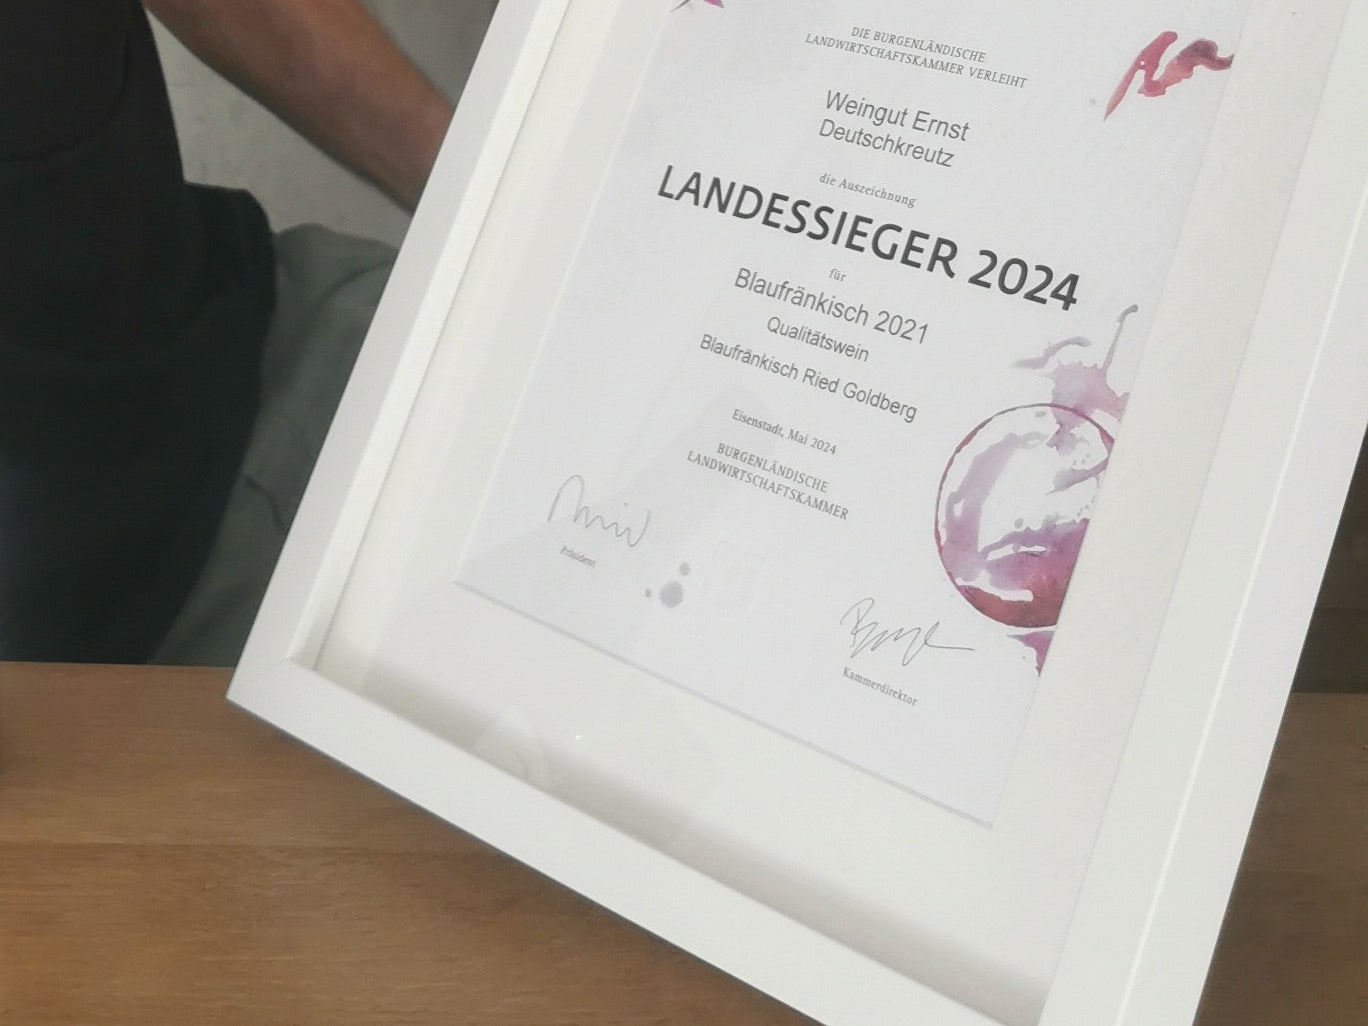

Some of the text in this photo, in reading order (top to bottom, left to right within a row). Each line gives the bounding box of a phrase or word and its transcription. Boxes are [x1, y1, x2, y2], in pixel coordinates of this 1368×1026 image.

[805, 33, 1028, 88] LANDWIRTSCHAFTSKAMMER VERLEIHT
[851, 26, 986, 63] DIE BURGENLÄNDISCHE
[825, 89, 970, 141] Weingut Ernst
[819, 119, 955, 167] Deutschkreutz
[819, 173, 917, 209] die Auszeichnung
[657, 164, 1080, 311] LANDESSIEGER 2024
[828, 268, 847, 282] für
[734, 267, 929, 344] Blaufränkisch 2021
[767, 316, 870, 362] Qualitätswein
[700, 334, 917, 424] Blaufränkisch Ried Goldberg
[788, 428, 809, 445] Mai
[810, 438, 837, 456] 2024
[687, 450, 849, 521] LANDWIRTSCHAFTSKAMMER
[717, 442, 829, 493] BURGENLÄNDISCHE
[843, 666, 918, 706] Kammerdirektor
